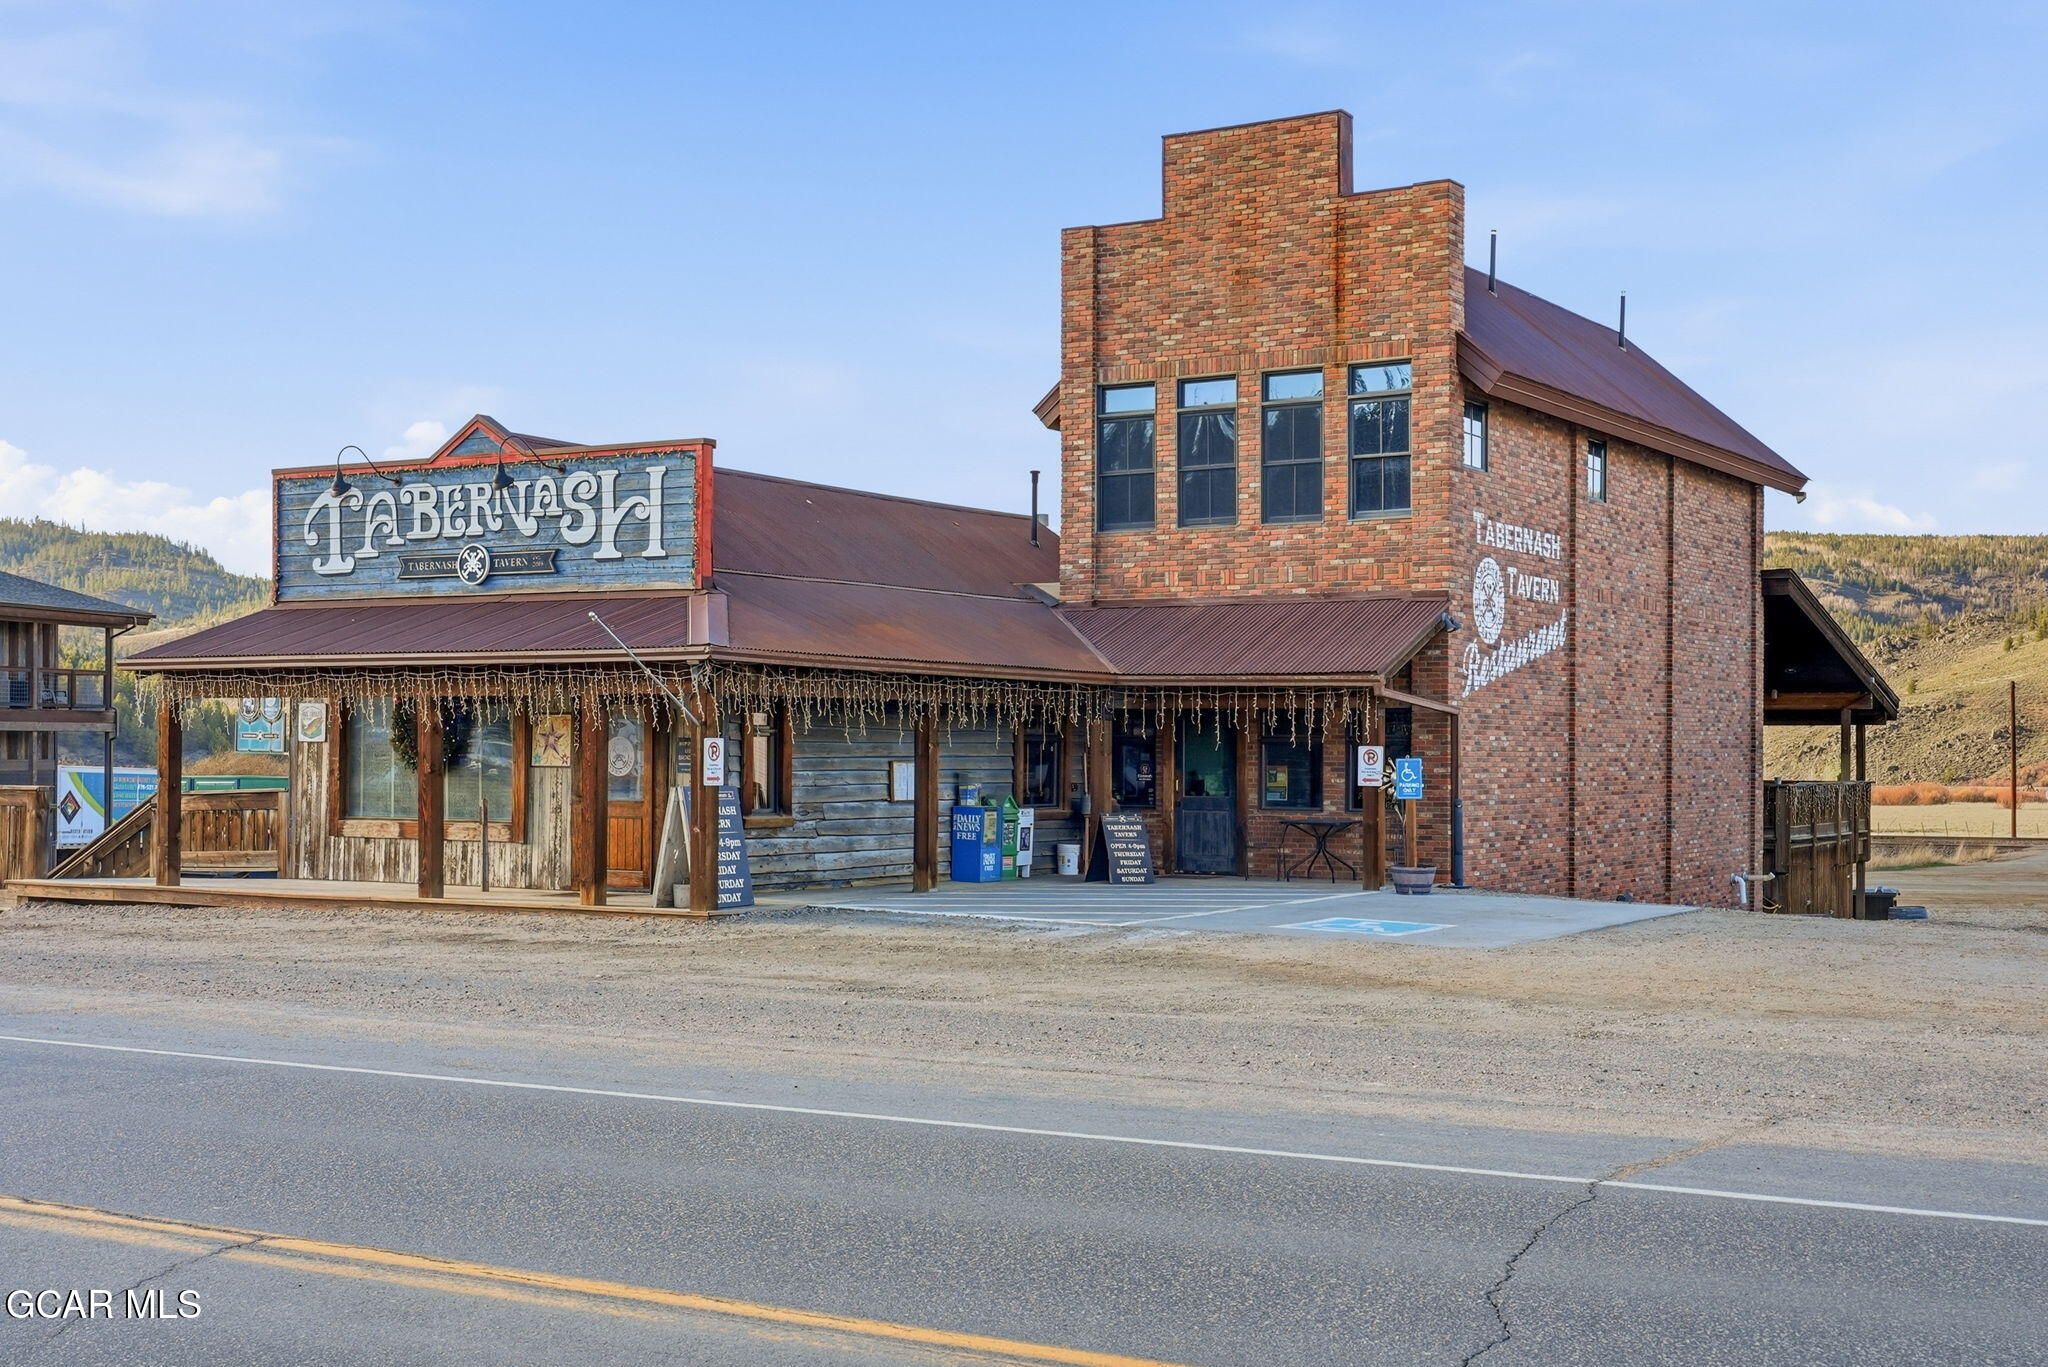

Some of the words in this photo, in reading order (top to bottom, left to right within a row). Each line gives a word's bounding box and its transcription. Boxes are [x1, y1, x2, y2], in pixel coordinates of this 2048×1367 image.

[304, 465, 667, 574] TABERNASH
[1473, 511, 1561, 560] TABERNASH
[408, 560, 458, 571] TABERNASH
[493, 557, 528, 568] TAVERN
[1507, 566, 1559, 604] TAVERN
[957, 814, 981, 823] DAILY
[956, 823, 980, 832] NEWS
[956, 832, 977, 840] FREE
[718, 838, 741, 849] 4-9pm
